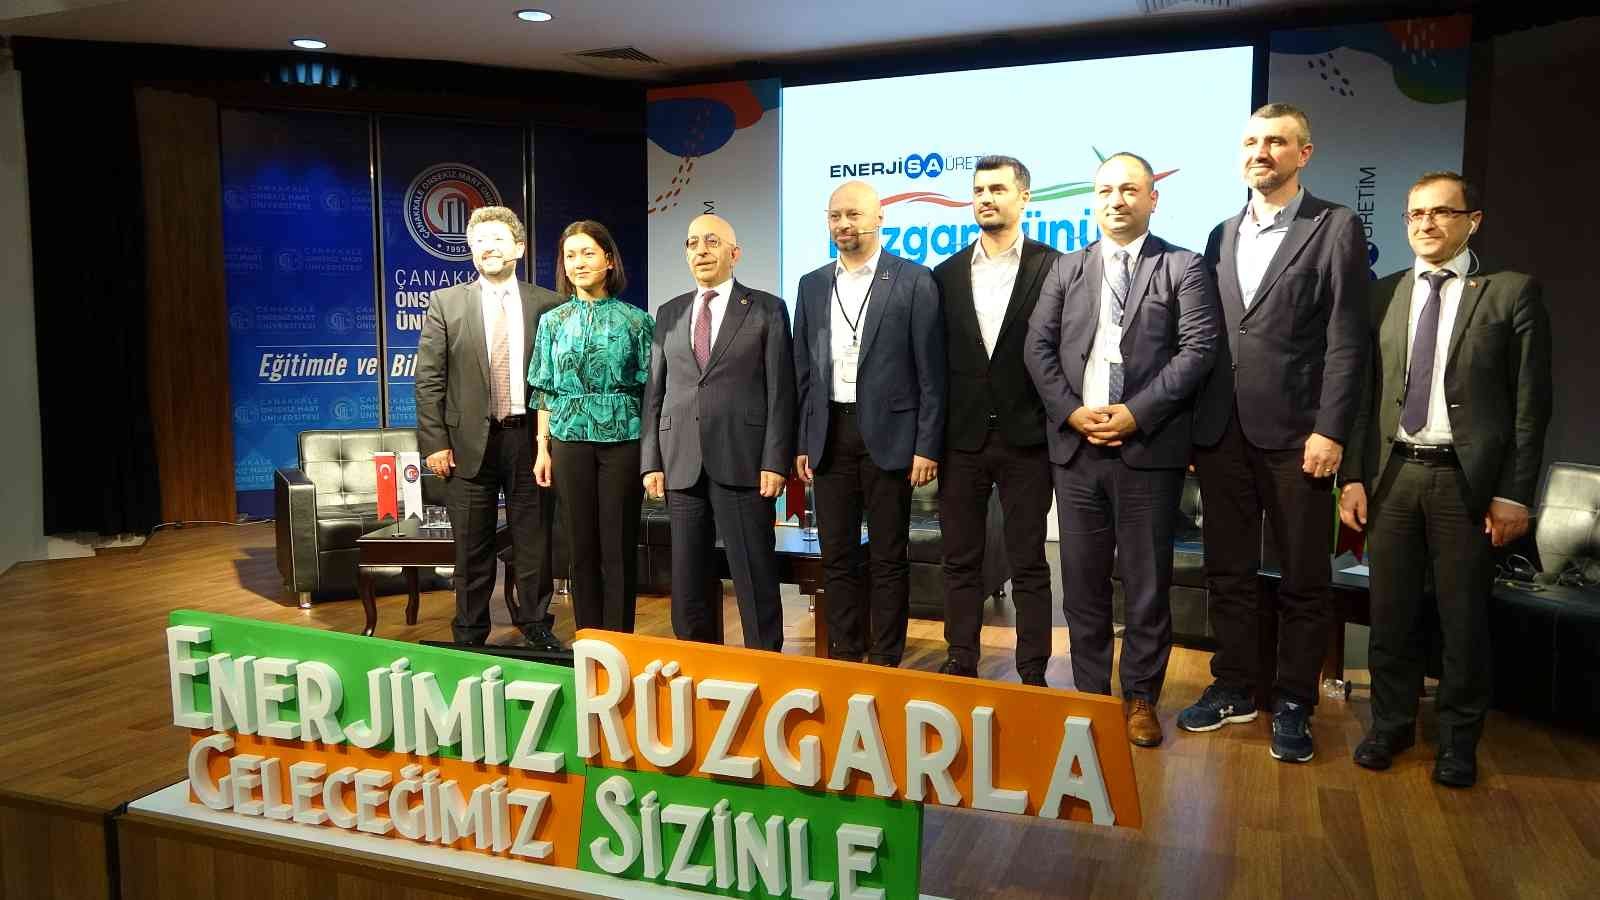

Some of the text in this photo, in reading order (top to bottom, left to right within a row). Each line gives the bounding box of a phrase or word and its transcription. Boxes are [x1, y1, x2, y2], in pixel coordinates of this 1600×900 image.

[945, 155, 985, 171] ÜRET
[446, 245, 467, 254] 1992
[395, 269, 477, 289] ÇANAKK
[395, 292, 432, 308] ONS
[396, 311, 426, 331] ÜNİ
[259, 353, 417, 382] Eğitimde ve Bil
[166, 624, 1115, 827] ENERJİMİZ RÜZGARLA
[188, 733, 885, 900] GELECEĞİMİZ SİZİNLE
